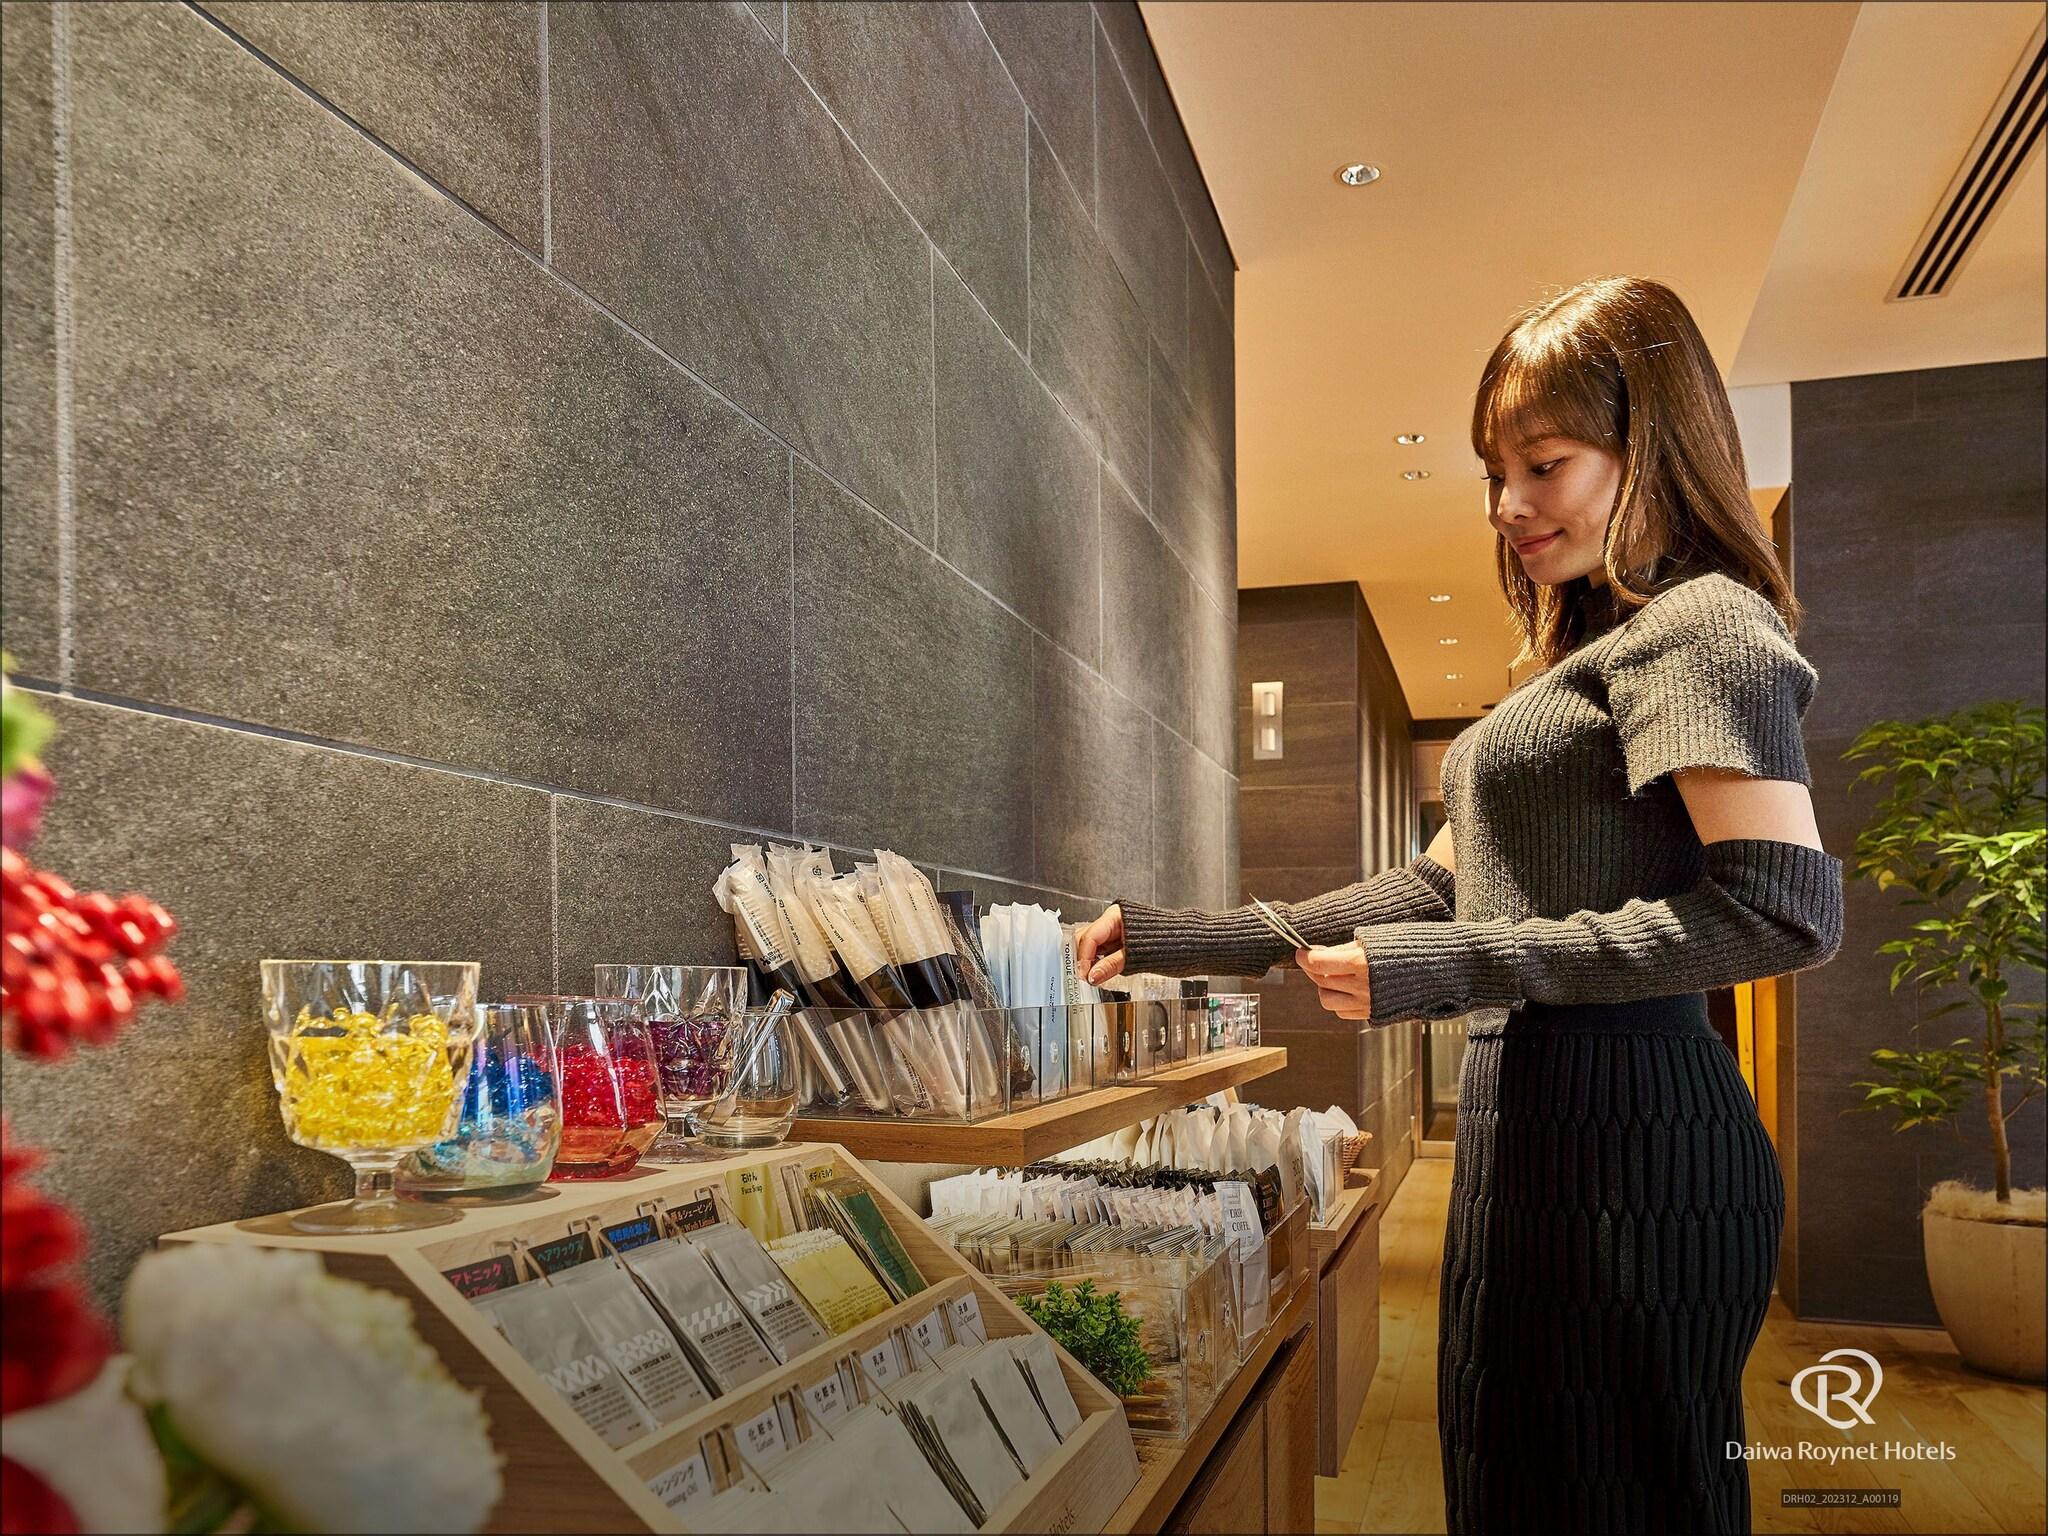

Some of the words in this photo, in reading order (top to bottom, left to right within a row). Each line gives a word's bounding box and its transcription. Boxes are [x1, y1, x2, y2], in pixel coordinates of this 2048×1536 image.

[1065, 943, 1073, 976] TONGUE
[814, 1382, 837, 1402] 化粧水
[748, 1418, 774, 1441] 化粧水
